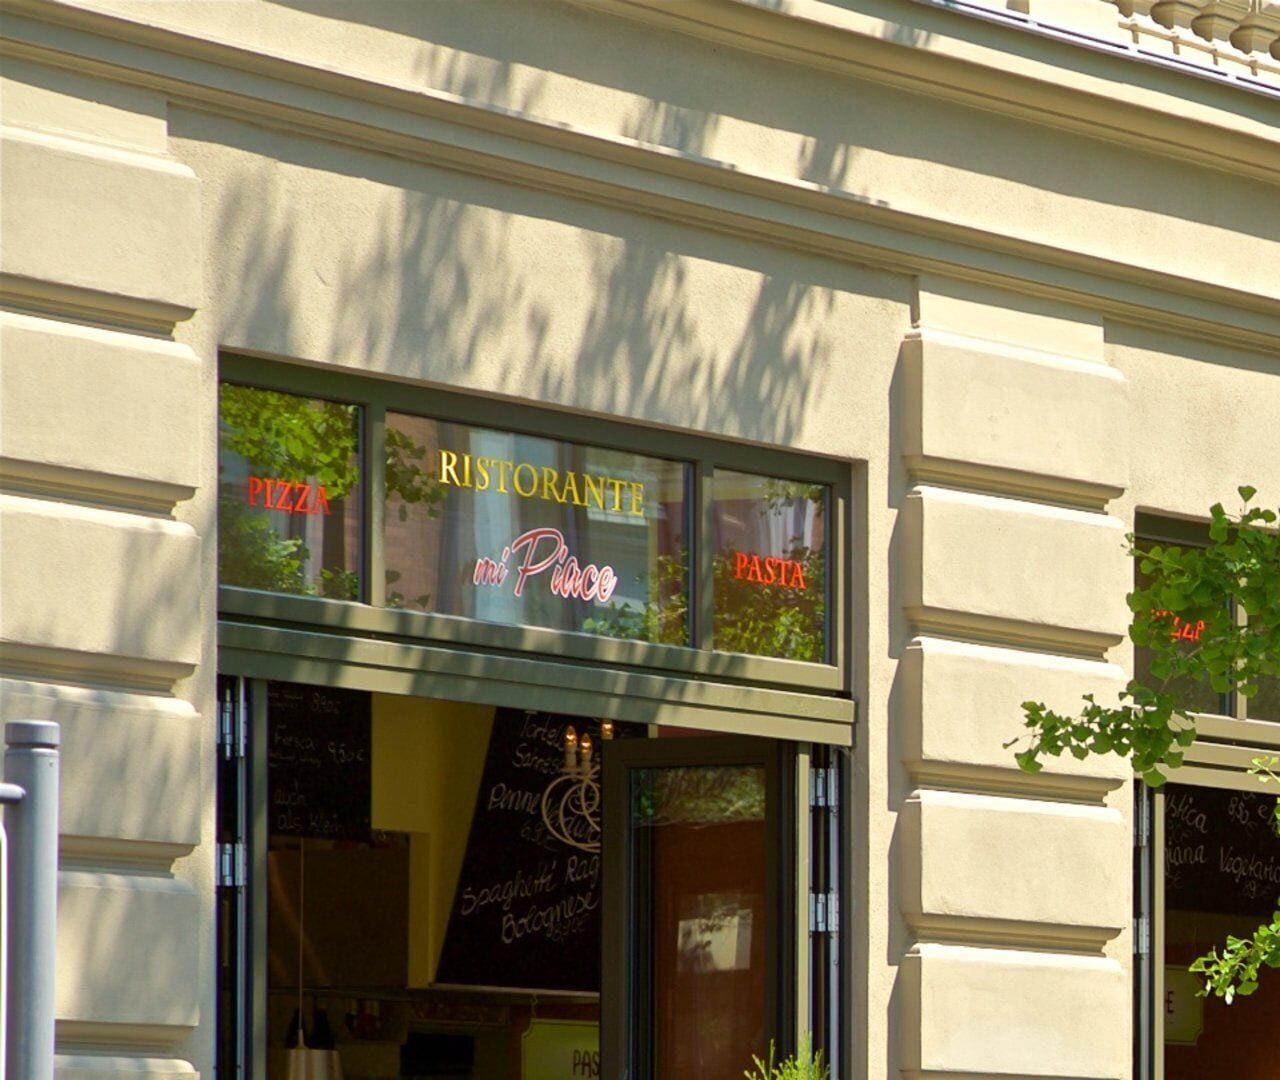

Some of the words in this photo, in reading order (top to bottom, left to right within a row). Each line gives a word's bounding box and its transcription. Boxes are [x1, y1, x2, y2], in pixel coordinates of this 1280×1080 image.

[248, 475, 332, 516] PIZZA
[438, 449, 645, 518] RISTORANTE
[472, 547, 510, 588] mi
[509, 527, 618, 602] Piace
[733, 552, 807, 590] PASTA
[461, 861, 558, 917] Spaghetti
[502, 891, 600, 944] Bolognese
